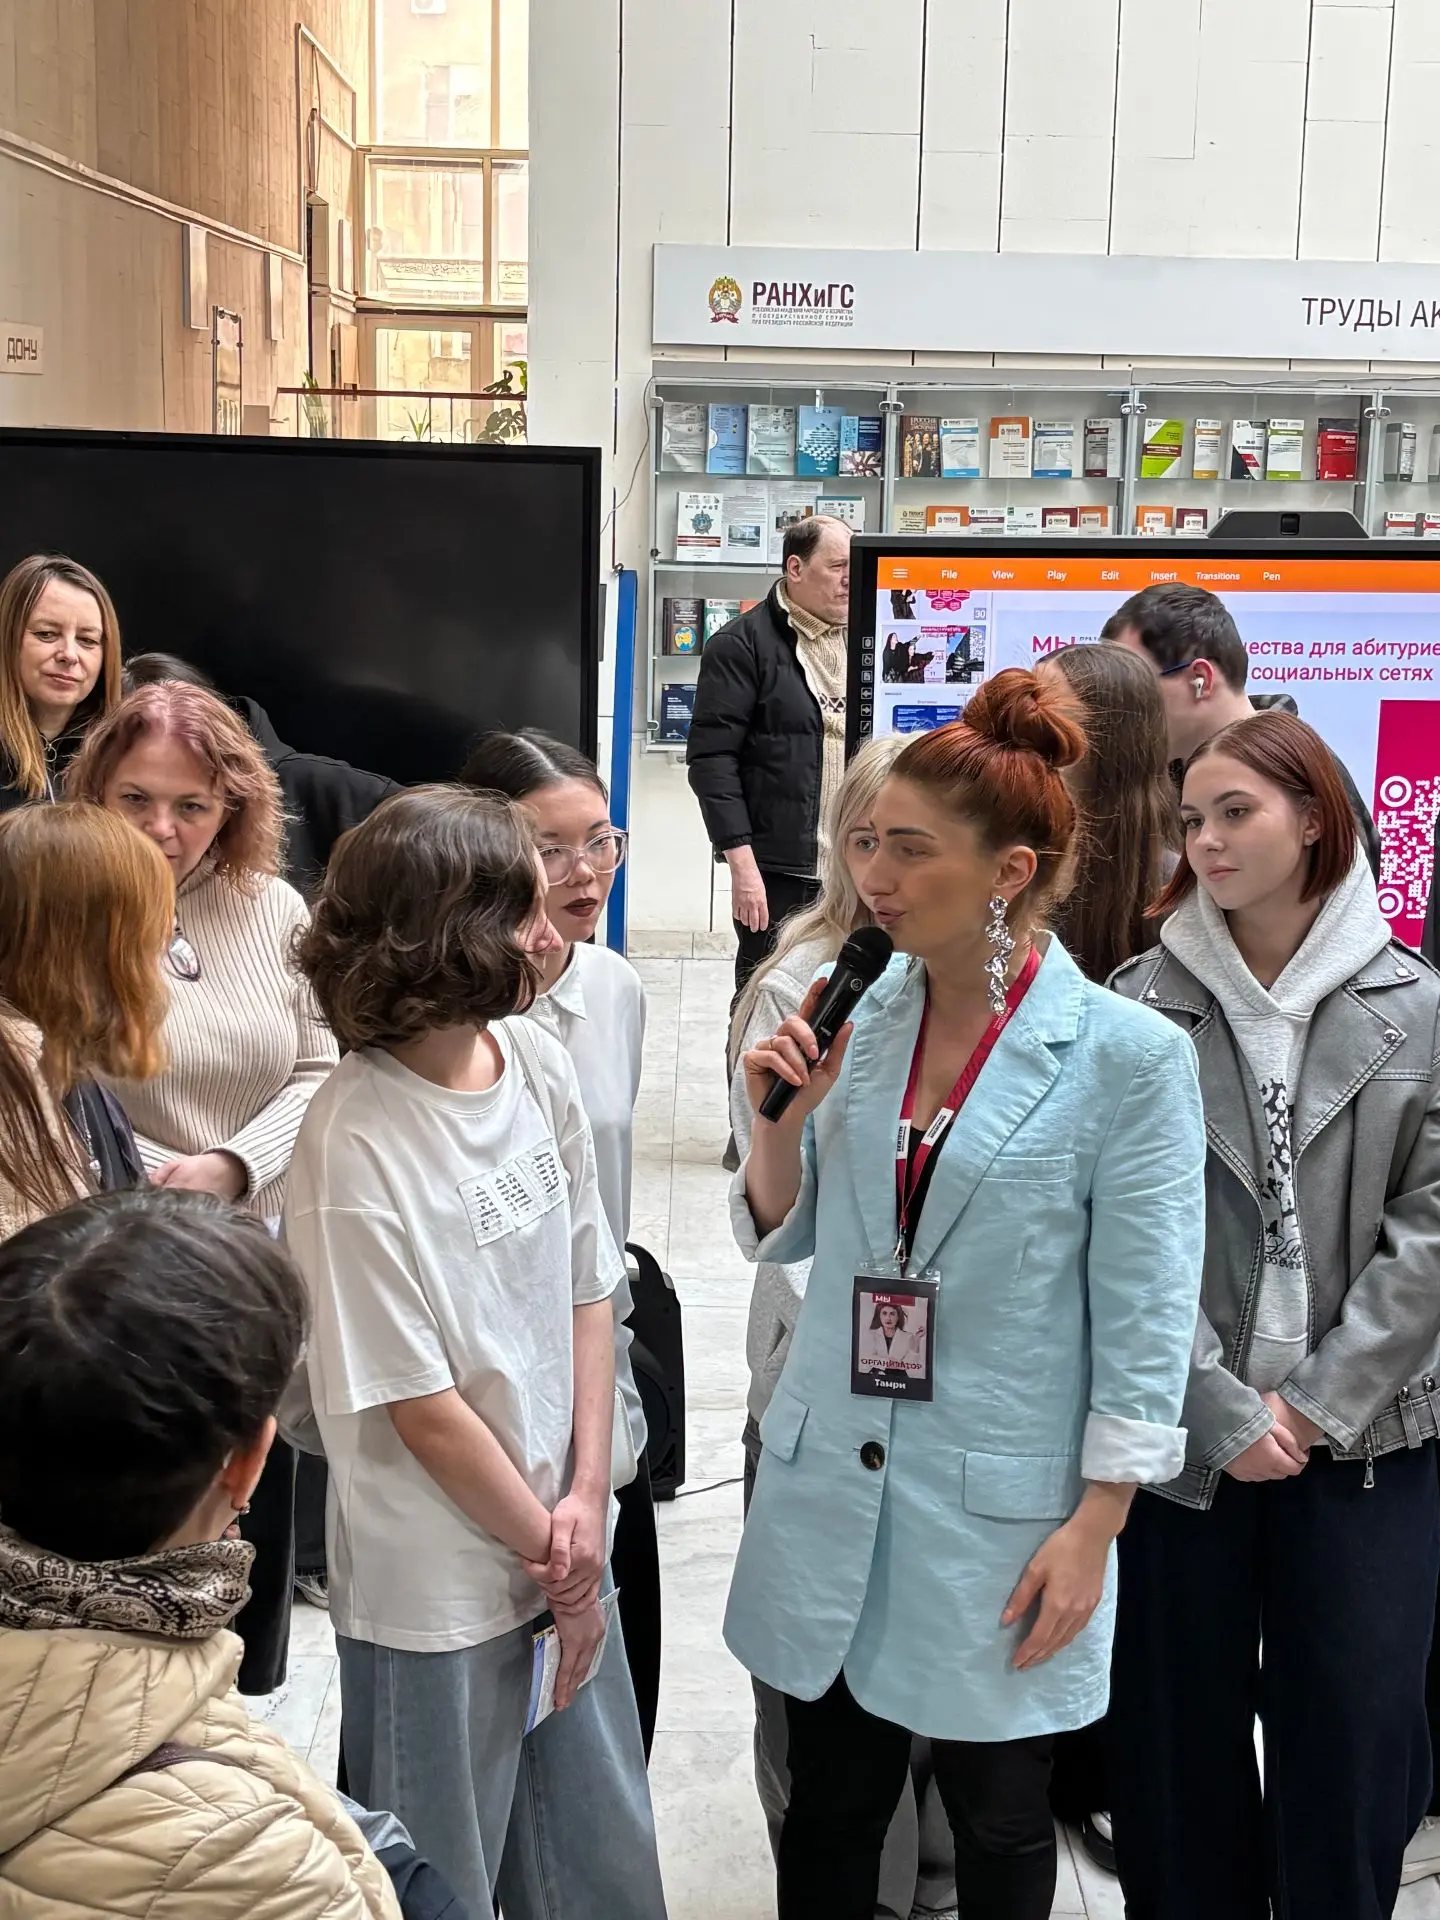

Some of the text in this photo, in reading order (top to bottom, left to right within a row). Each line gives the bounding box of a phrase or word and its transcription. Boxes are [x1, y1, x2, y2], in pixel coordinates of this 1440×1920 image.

[752, 282, 854, 308] РАНХиГС
[1302, 298, 1401, 332] ТРУДЫ
[7, 337, 37, 363] ДОНУ
[941, 569, 1281, 582] File View Play Edit Insert Transitions Pen
[1032, 635, 1075, 653] МЫ
[1244, 641, 1304, 655] ества
[1309, 642, 1346, 657] для
[1352, 638, 1440, 660] абитурие
[1251, 667, 1434, 683] социальных сетях
[875, 1295, 891, 1303] МЫ
[861, 1359, 922, 1370] ОРГАНИЗАТОР
[874, 1378, 906, 1390] Тамри
